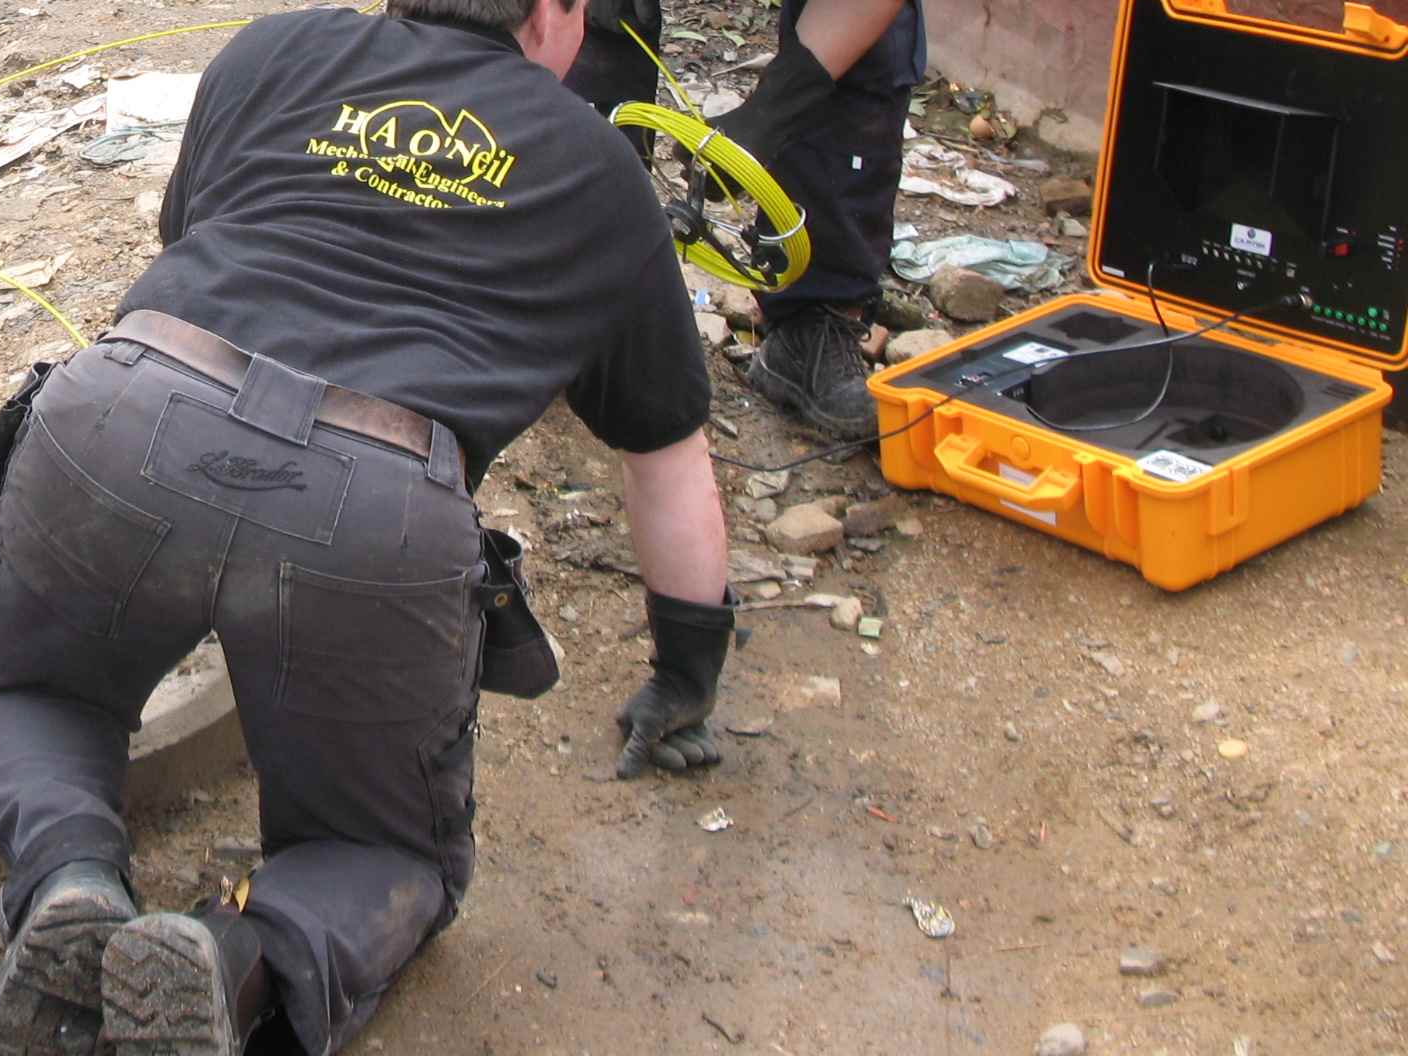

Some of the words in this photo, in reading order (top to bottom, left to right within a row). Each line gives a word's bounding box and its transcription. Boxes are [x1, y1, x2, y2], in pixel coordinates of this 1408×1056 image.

[331, 104, 368, 135] H
[369, 116, 399, 149] A
[331, 160, 350, 177] &
